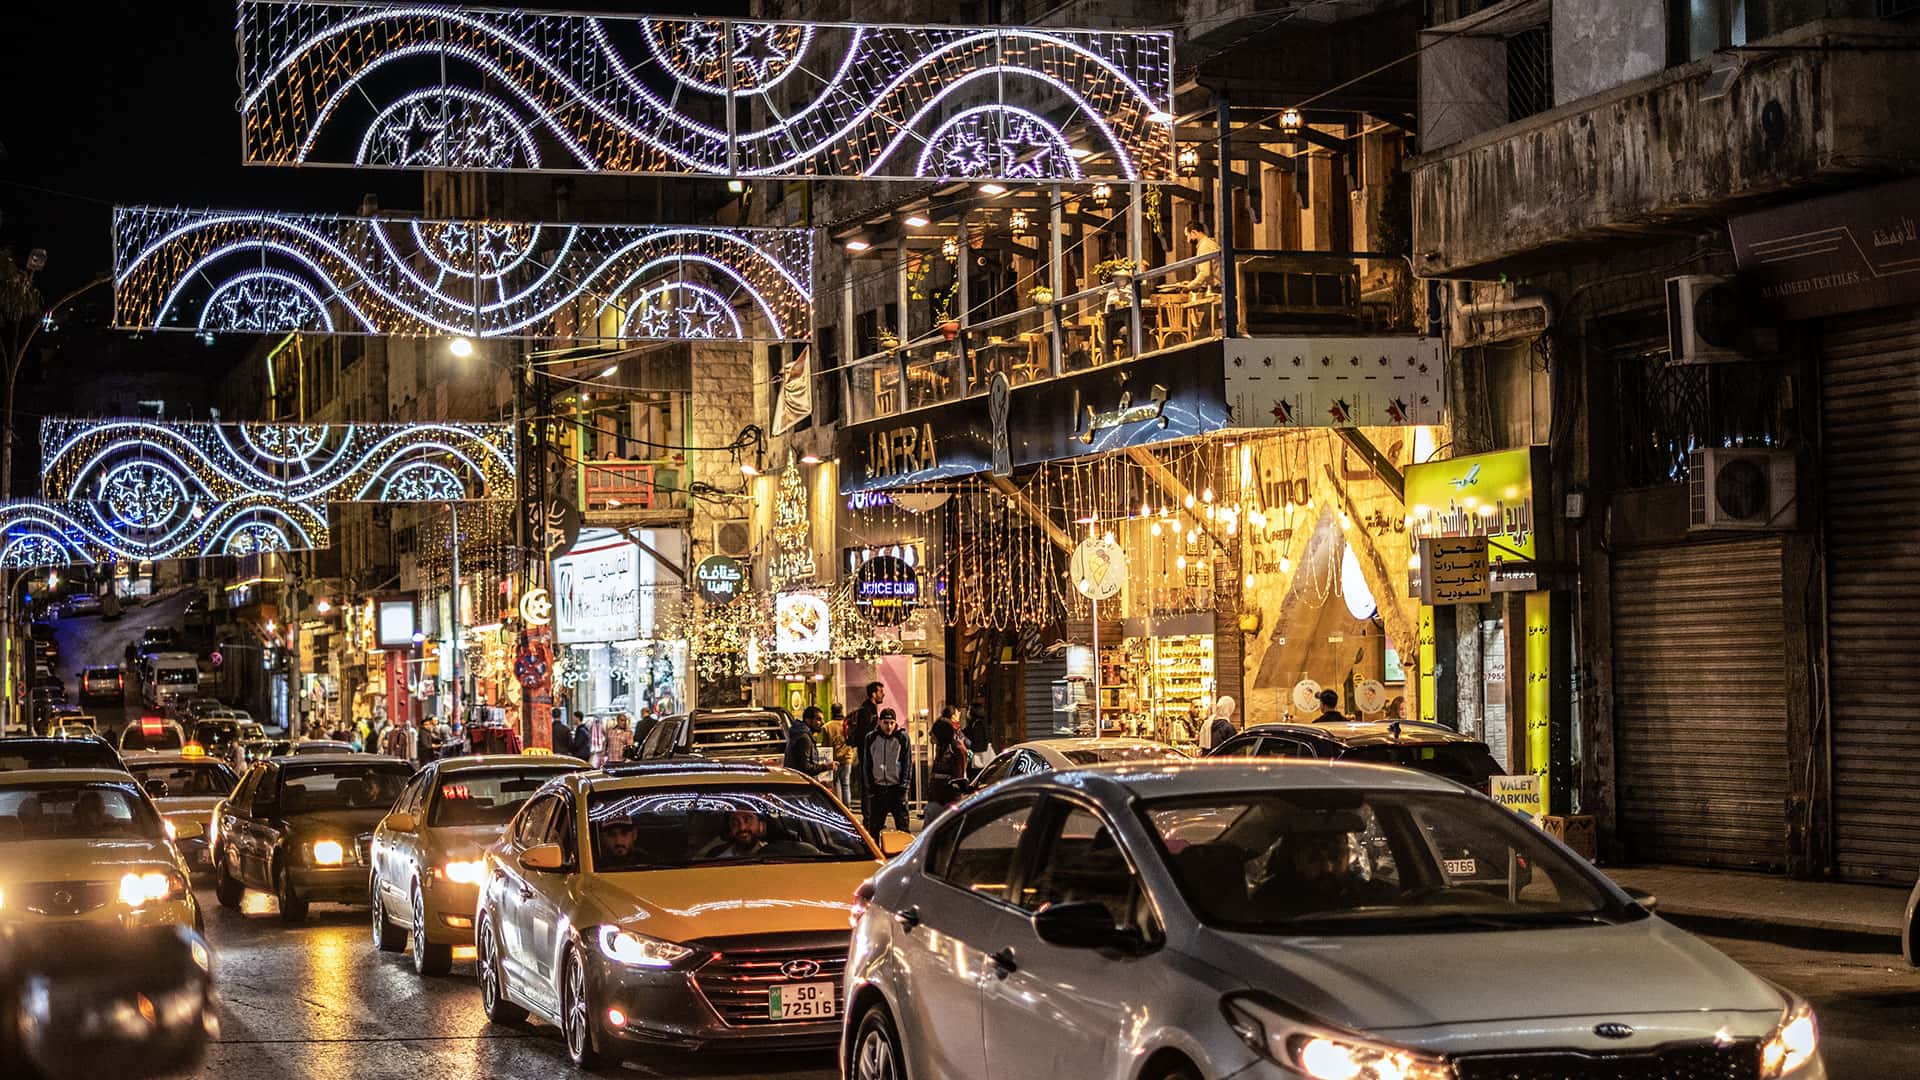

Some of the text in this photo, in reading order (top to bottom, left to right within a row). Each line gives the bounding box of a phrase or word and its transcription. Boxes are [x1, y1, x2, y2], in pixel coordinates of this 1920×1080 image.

[1811, 271, 1860, 290] TEXTILES
[864, 423, 938, 480] JAFRA
[1433, 539, 1485, 558] شحن
[699, 564, 741, 580] كنافة
[1434, 572, 1487, 587] الكويت
[860, 581, 915, 594] JUICE CLUB
[1436, 588, 1487, 601] السعودية
[1500, 781, 1532, 791] VALET
[1494, 793, 1540, 804] PARKING
[798, 987, 816, 1000] 50
[783, 1001, 832, 1016] 72516
